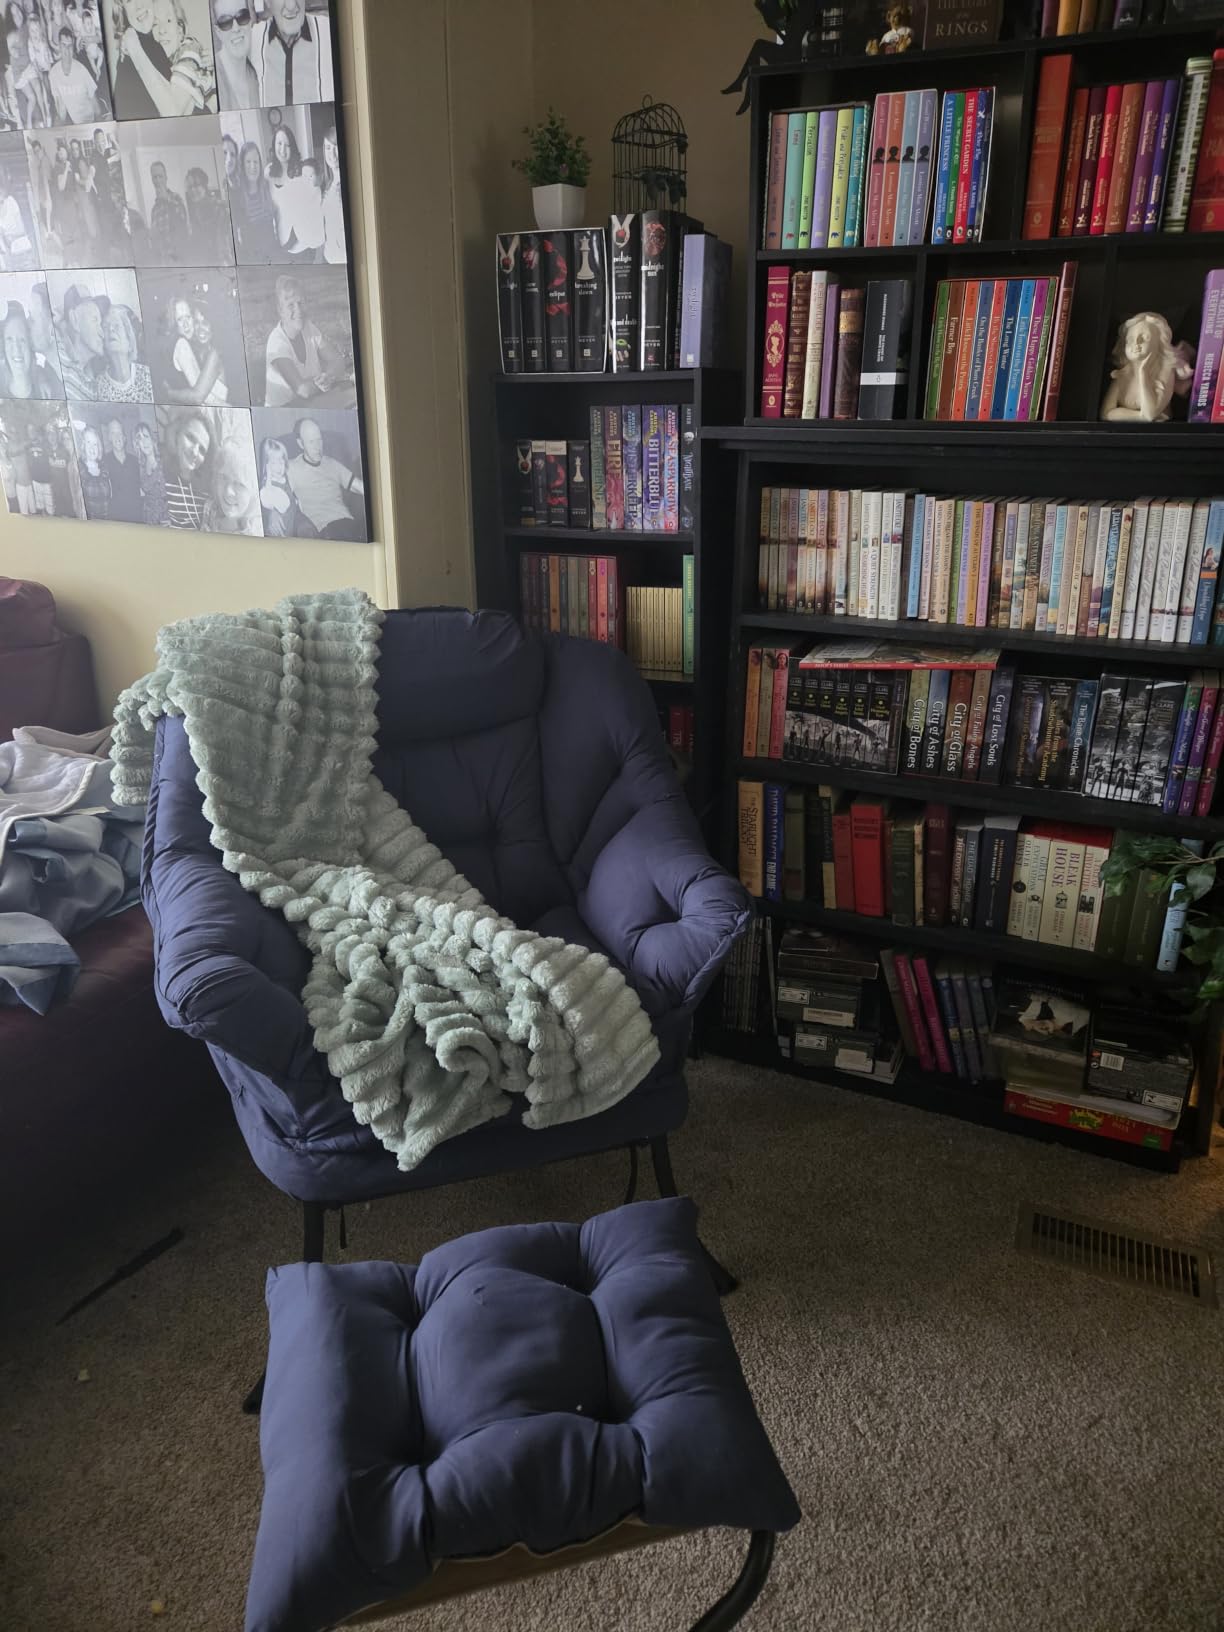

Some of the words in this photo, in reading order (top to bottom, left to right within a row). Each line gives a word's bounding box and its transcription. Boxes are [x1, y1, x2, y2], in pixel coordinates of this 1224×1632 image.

[935, 21, 989, 37] RINGS
[806, 126, 817, 157] Persuasion
[964, 116, 974, 143] SECRET
[942, 134, 951, 172] PRINCESS
[961, 144, 971, 175] GARDEN
[1204, 289, 1220, 336] EVERYTHING
[948, 316, 960, 340] Farmer
[1000, 348, 1010, 370] Winter
[1024, 357, 1035, 380] Golden
[1201, 352, 1215, 382] REBECCA
[1196, 382, 1210, 408] YARROS
[607, 439, 622, 480] FIRE
[682, 452, 695, 492] NIGHTBANE
[647, 438, 661, 515] BITTERBLUE
[666, 440, 678, 514] SEASPARROW
[1029, 541, 1040, 575] STRANGER
[909, 698, 925, 722] City
[929, 700, 944, 725] City
[949, 702, 967, 728] City
[973, 695, 985, 712] City
[992, 694, 1006, 714] City
[1079, 703, 1088, 717] The
[910, 723, 921, 734] of
[929, 726, 940, 737] of
[971, 720, 982, 743] Fallen
[992, 714, 1003, 723] of
[1043, 699, 1058, 750] Shadowhunter
[1053, 719, 1064, 735] Tales
[1074, 717, 1087, 737] Bane
[950, 729, 962, 741] of
[990, 724, 1003, 742] Lost
[1052, 734, 1062, 752] from
[906, 735, 923, 769] Bones
[925, 737, 940, 769] Ashes
[946, 741, 963, 772] Glass
[967, 744, 979, 769] Angels
[986, 743, 999, 767] Souls
[1069, 737, 1083, 777] Chronicles
[1037, 749, 1051, 782] Academy
[768, 789, 780, 817] DAVID
[747, 807, 759, 857] STARLIGHT
[767, 818, 779, 861] BALDACCI
[966, 854, 975, 873] ILIAD
[1014, 839, 1025, 867] TWIST
[1022, 839, 1033, 868] OLIVER
[766, 861, 778, 873] END
[1028, 844, 1041, 891] EXPECTATIONS
[1037, 855, 1048, 881] GREAT
[1051, 846, 1068, 887] HOUSE
[1065, 851, 1082, 886] BLEAK
[765, 873, 777, 891] GAME
[1080, 867, 1092, 893] CITIES
